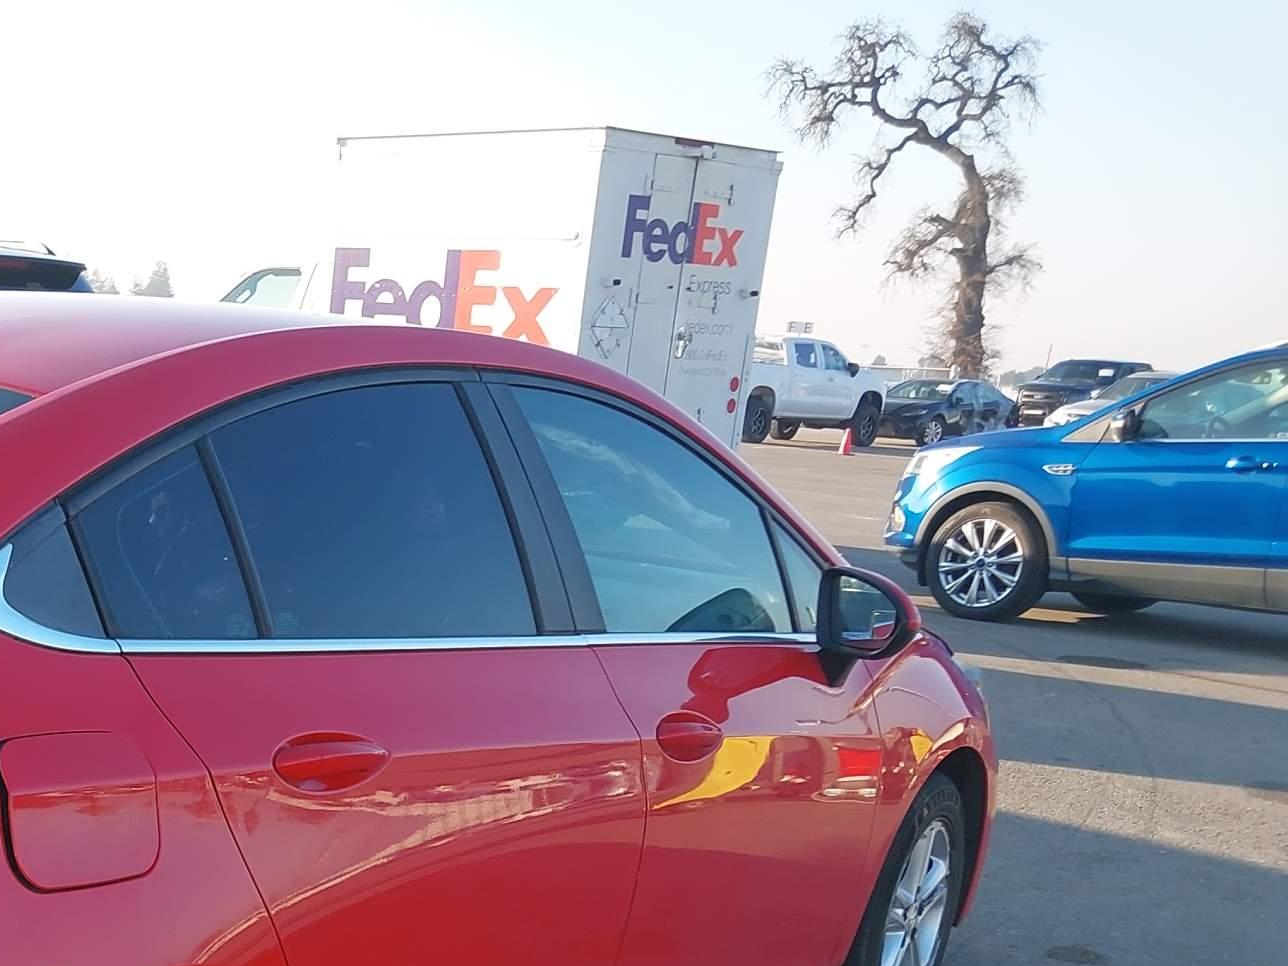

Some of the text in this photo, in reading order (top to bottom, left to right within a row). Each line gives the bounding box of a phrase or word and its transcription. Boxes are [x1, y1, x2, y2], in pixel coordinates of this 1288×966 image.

[620, 194, 744, 268] FedEx
[329, 247, 560, 346] FedEx
[689, 274, 731, 296] Express
